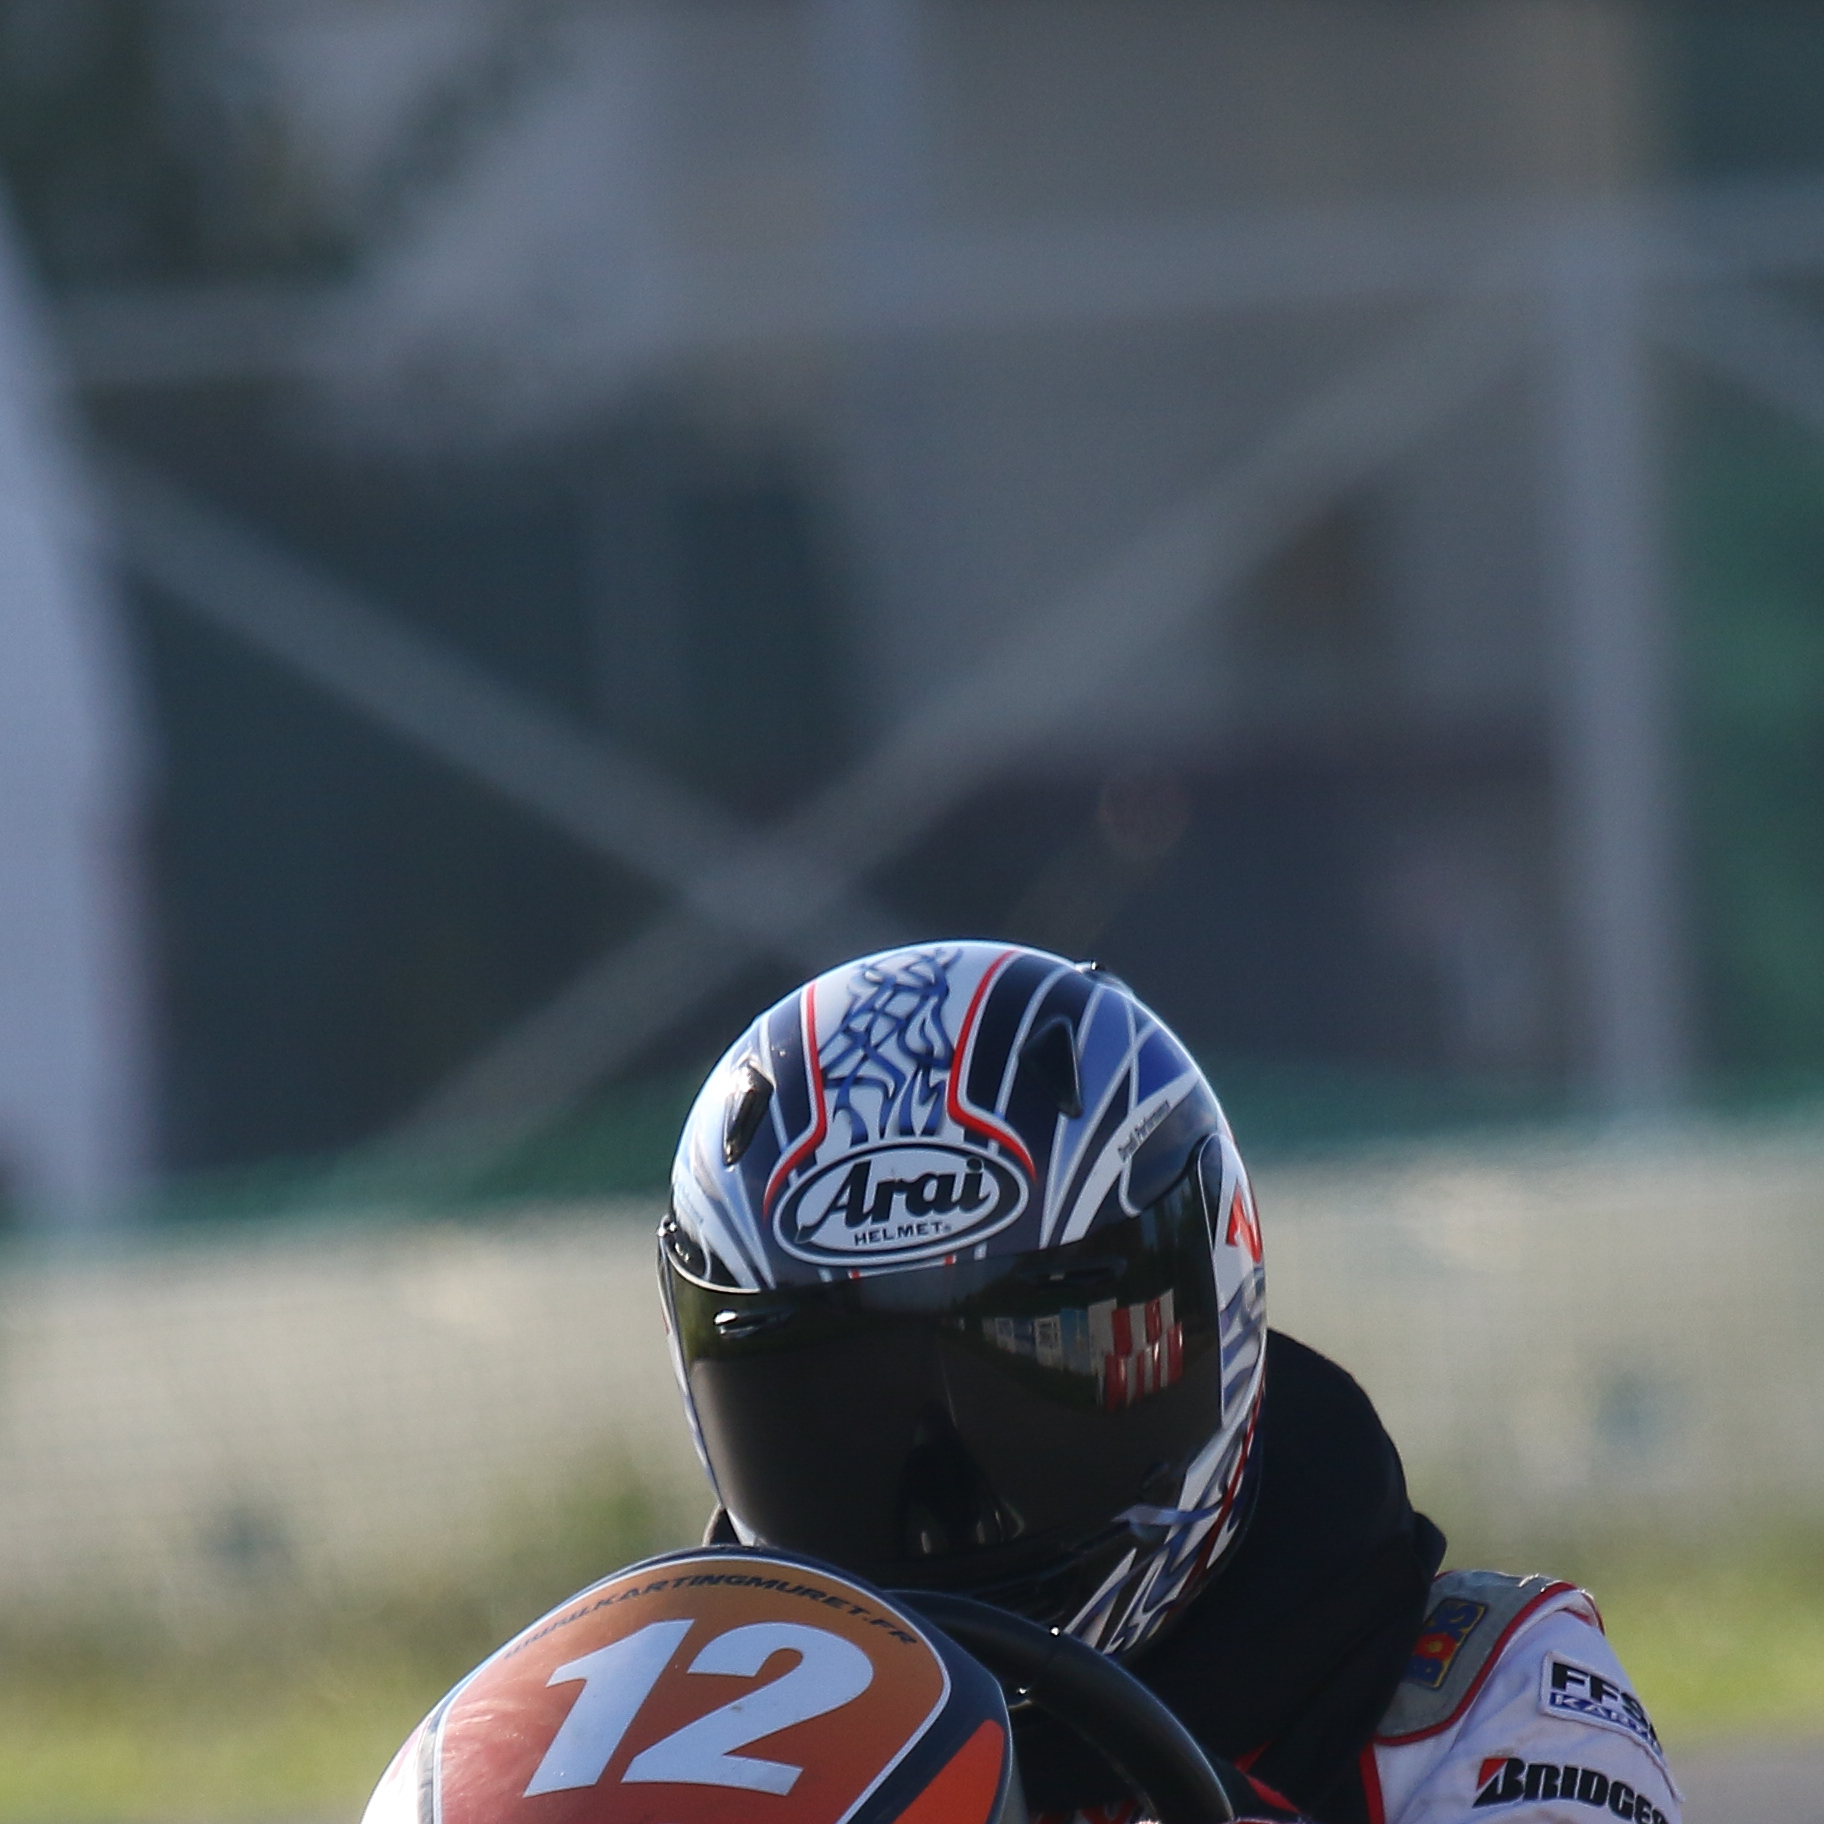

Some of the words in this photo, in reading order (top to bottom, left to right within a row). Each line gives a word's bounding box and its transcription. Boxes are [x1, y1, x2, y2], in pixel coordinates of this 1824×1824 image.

[795, 1157, 991, 1243] Arai
[853, 1221, 943, 1246] HELMET
[522, 1618, 874, 1798] 12
